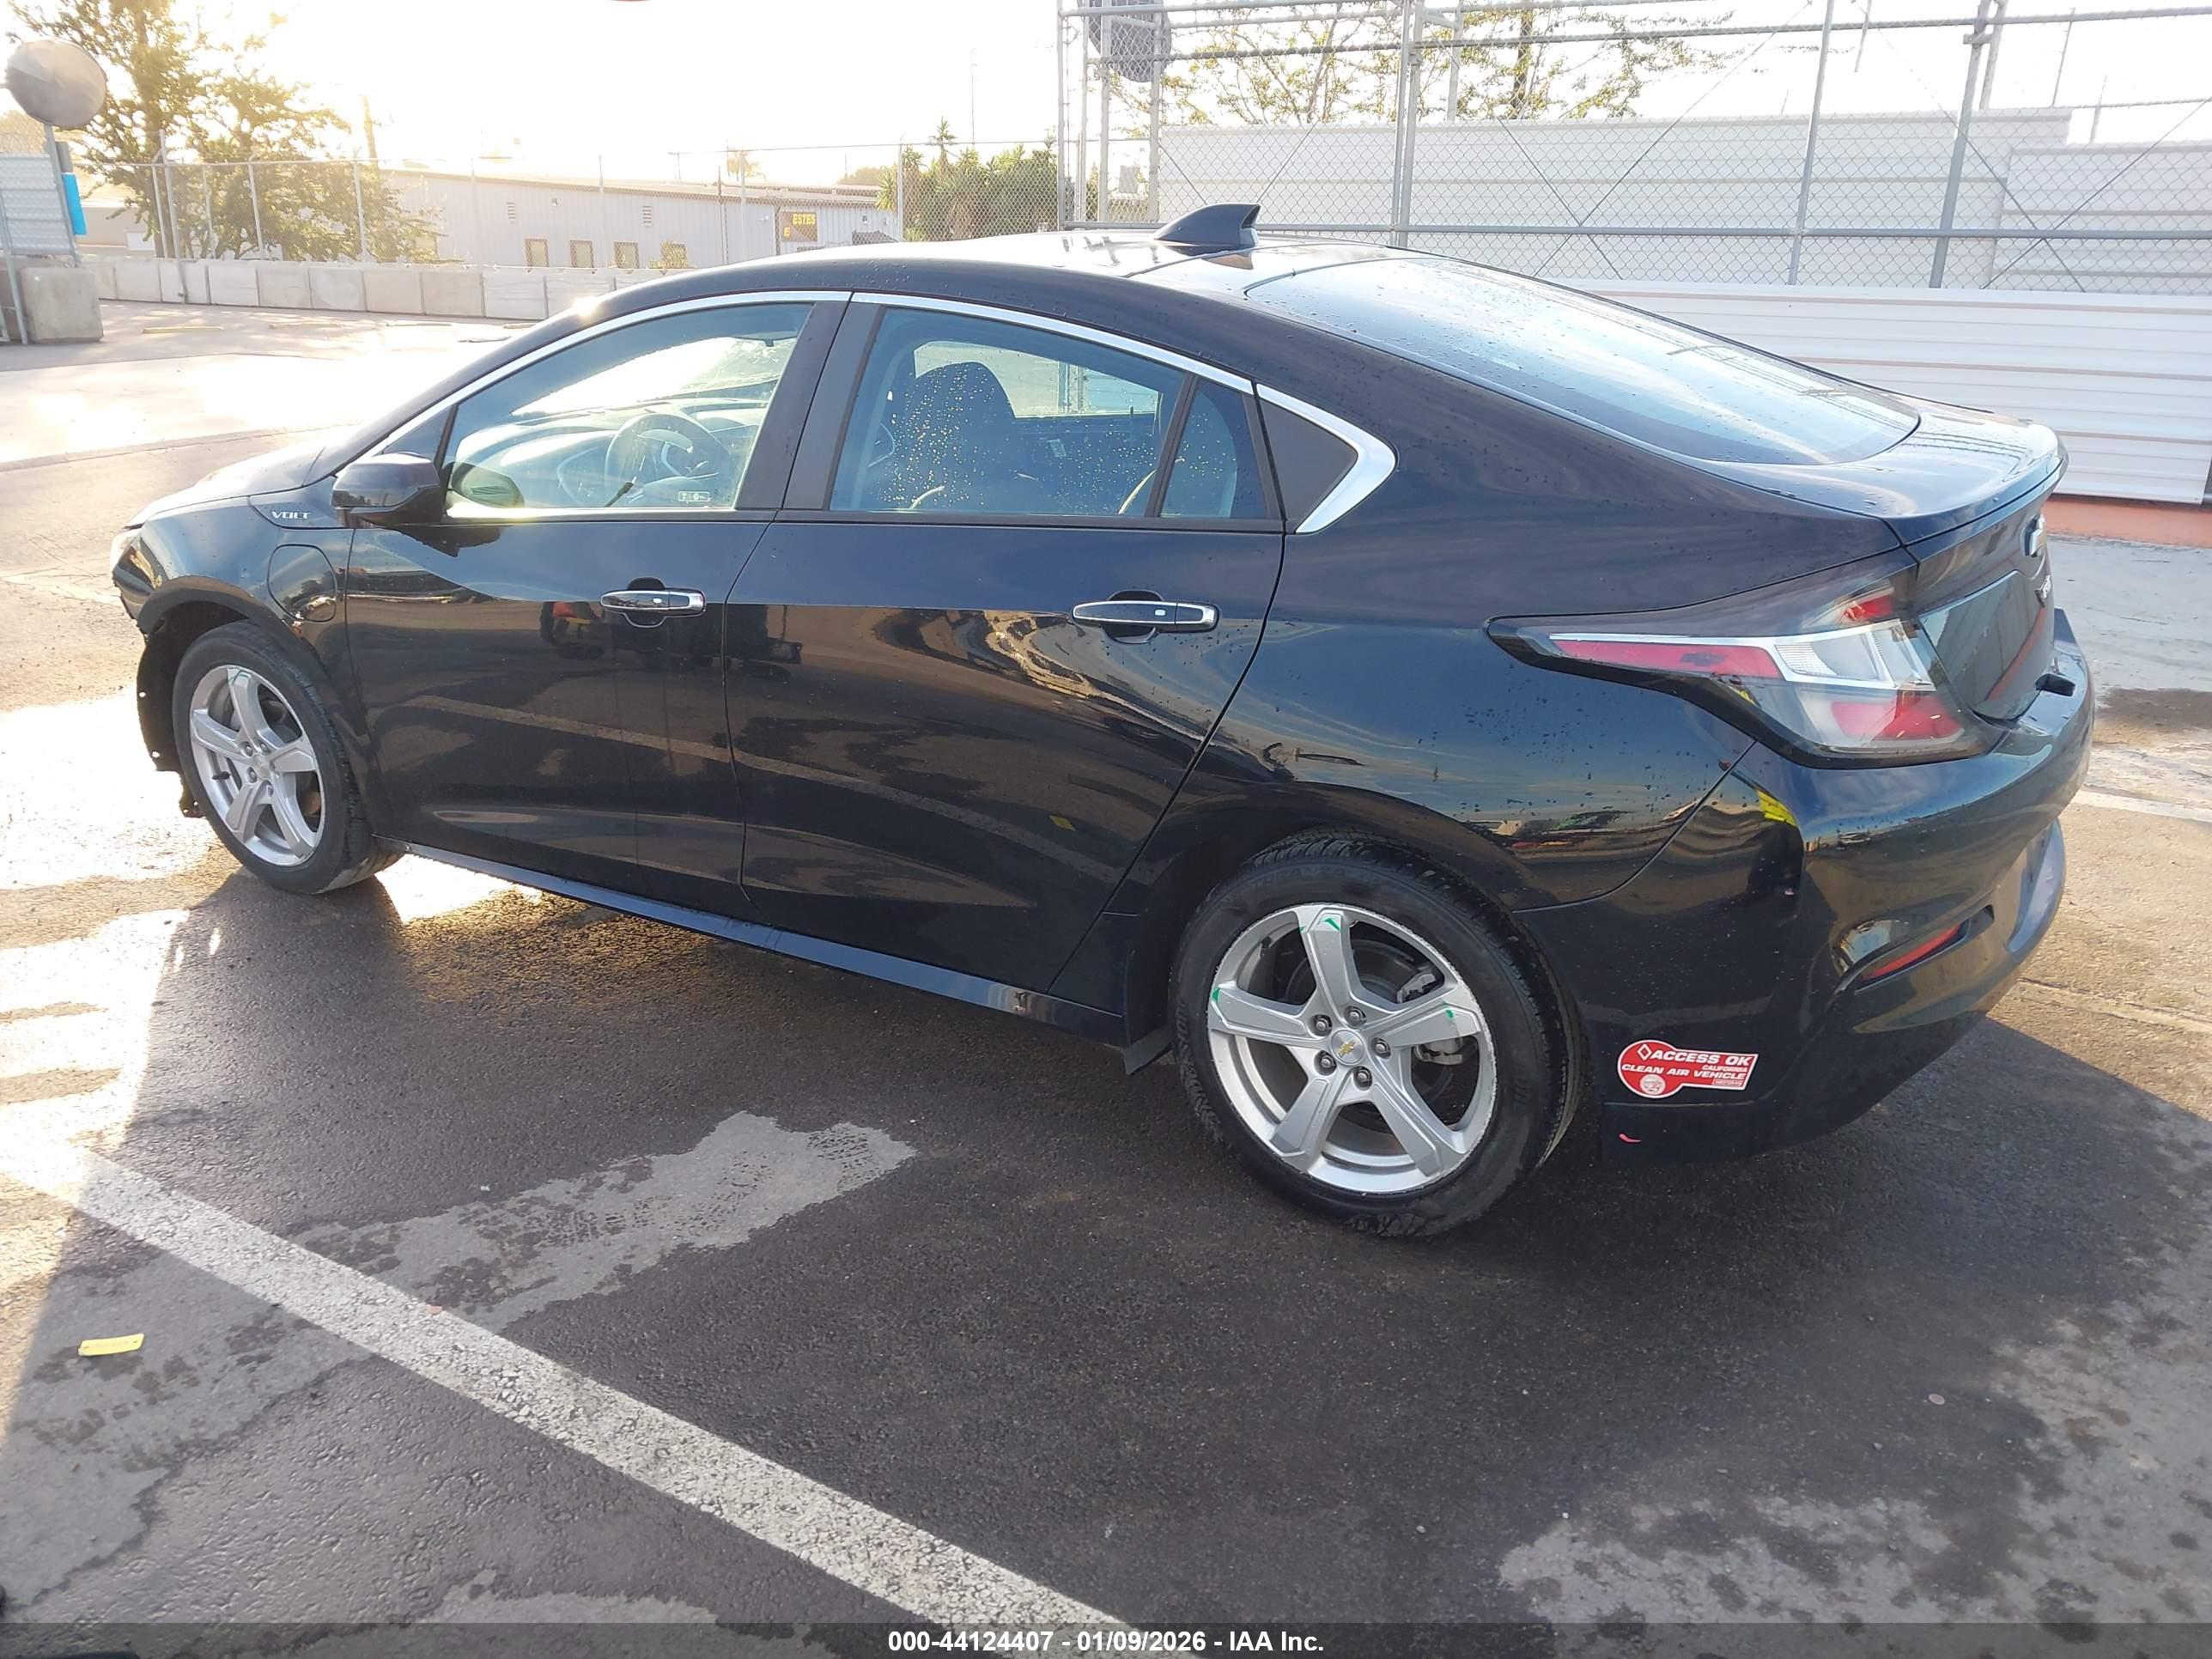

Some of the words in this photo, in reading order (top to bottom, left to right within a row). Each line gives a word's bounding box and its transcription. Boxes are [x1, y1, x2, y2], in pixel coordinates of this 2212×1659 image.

[792, 212, 817, 225] ESTES
[271, 511, 312, 520] VOLT
[1650, 1049, 1719, 1065] ACCESS
[1724, 1055, 1753, 1066] OK
[1621, 1063, 1664, 1074] CLEAN
[1666, 1068, 1690, 1077] AIR
[1693, 1071, 1747, 1080] VEHICLE
